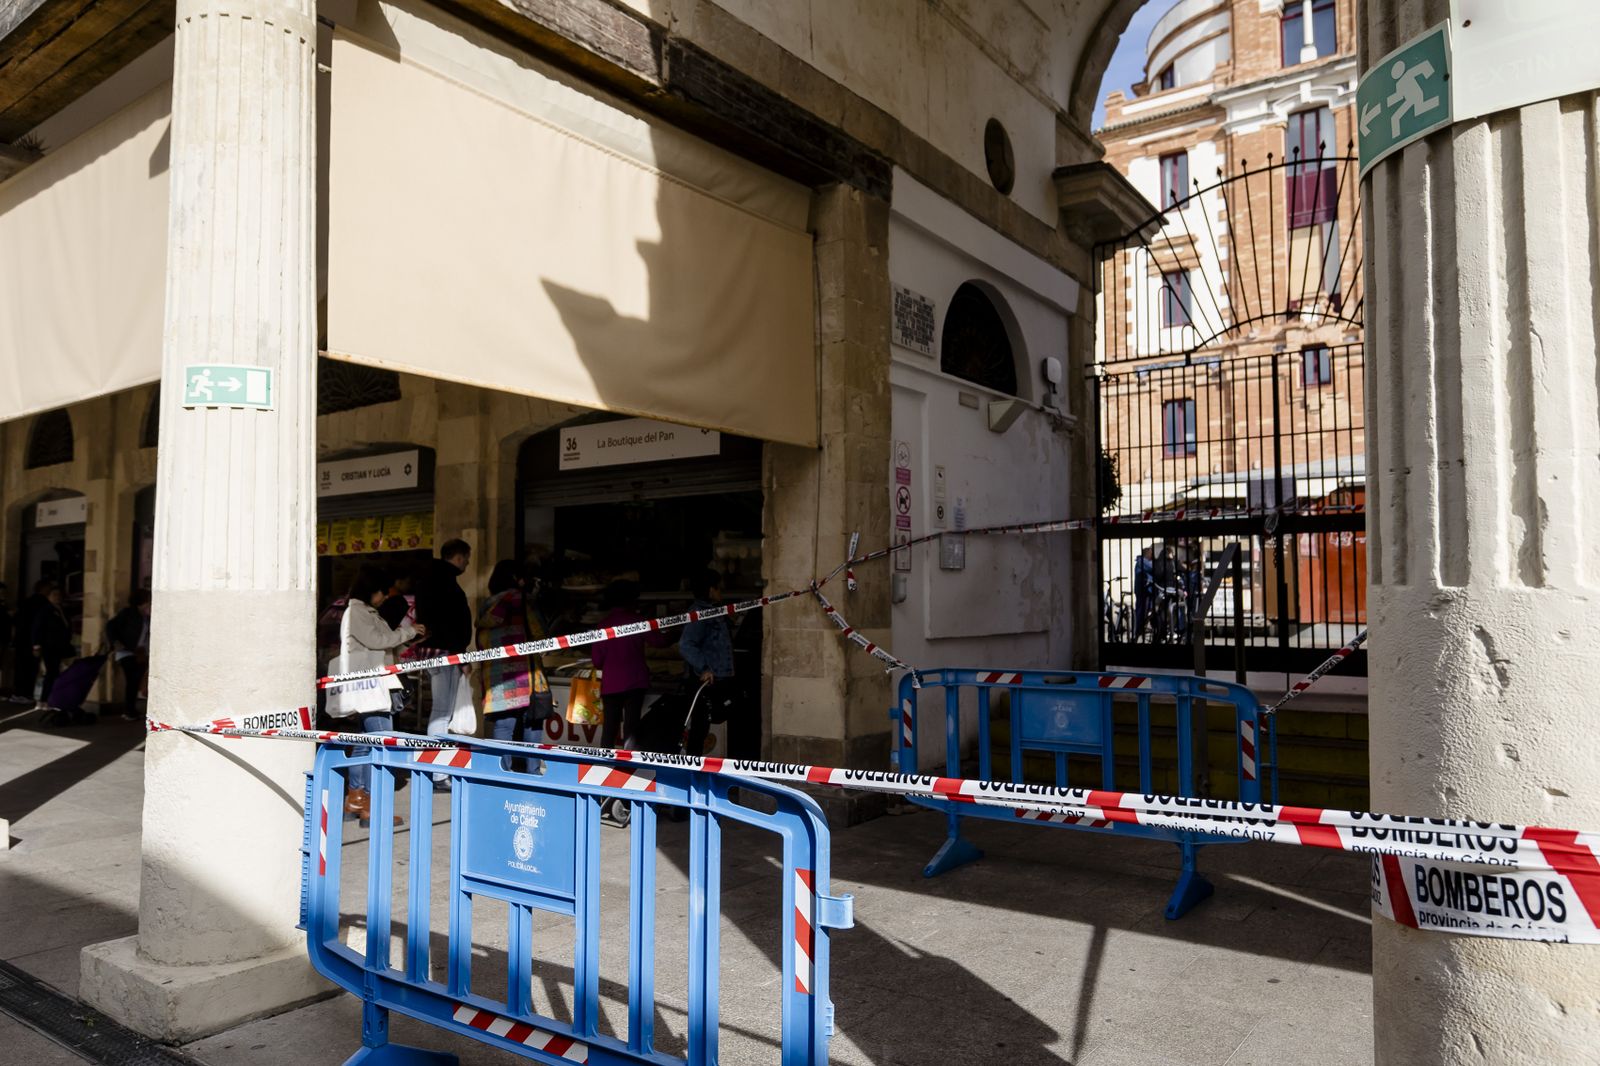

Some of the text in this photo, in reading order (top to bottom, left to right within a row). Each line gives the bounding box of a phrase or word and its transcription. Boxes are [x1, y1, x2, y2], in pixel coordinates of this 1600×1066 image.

[566, 437, 577, 451] 36
[597, 430, 674, 449] La Boutique del Pan
[341, 470, 367, 482] CRISTIAN
[368, 470, 372, 479] Y
[244, 711, 298, 729] BOMBEROS
[503, 800, 546, 818] Ayuntamiento
[510, 813, 519, 824] de
[1415, 863, 1567, 923] BOMBEROS
